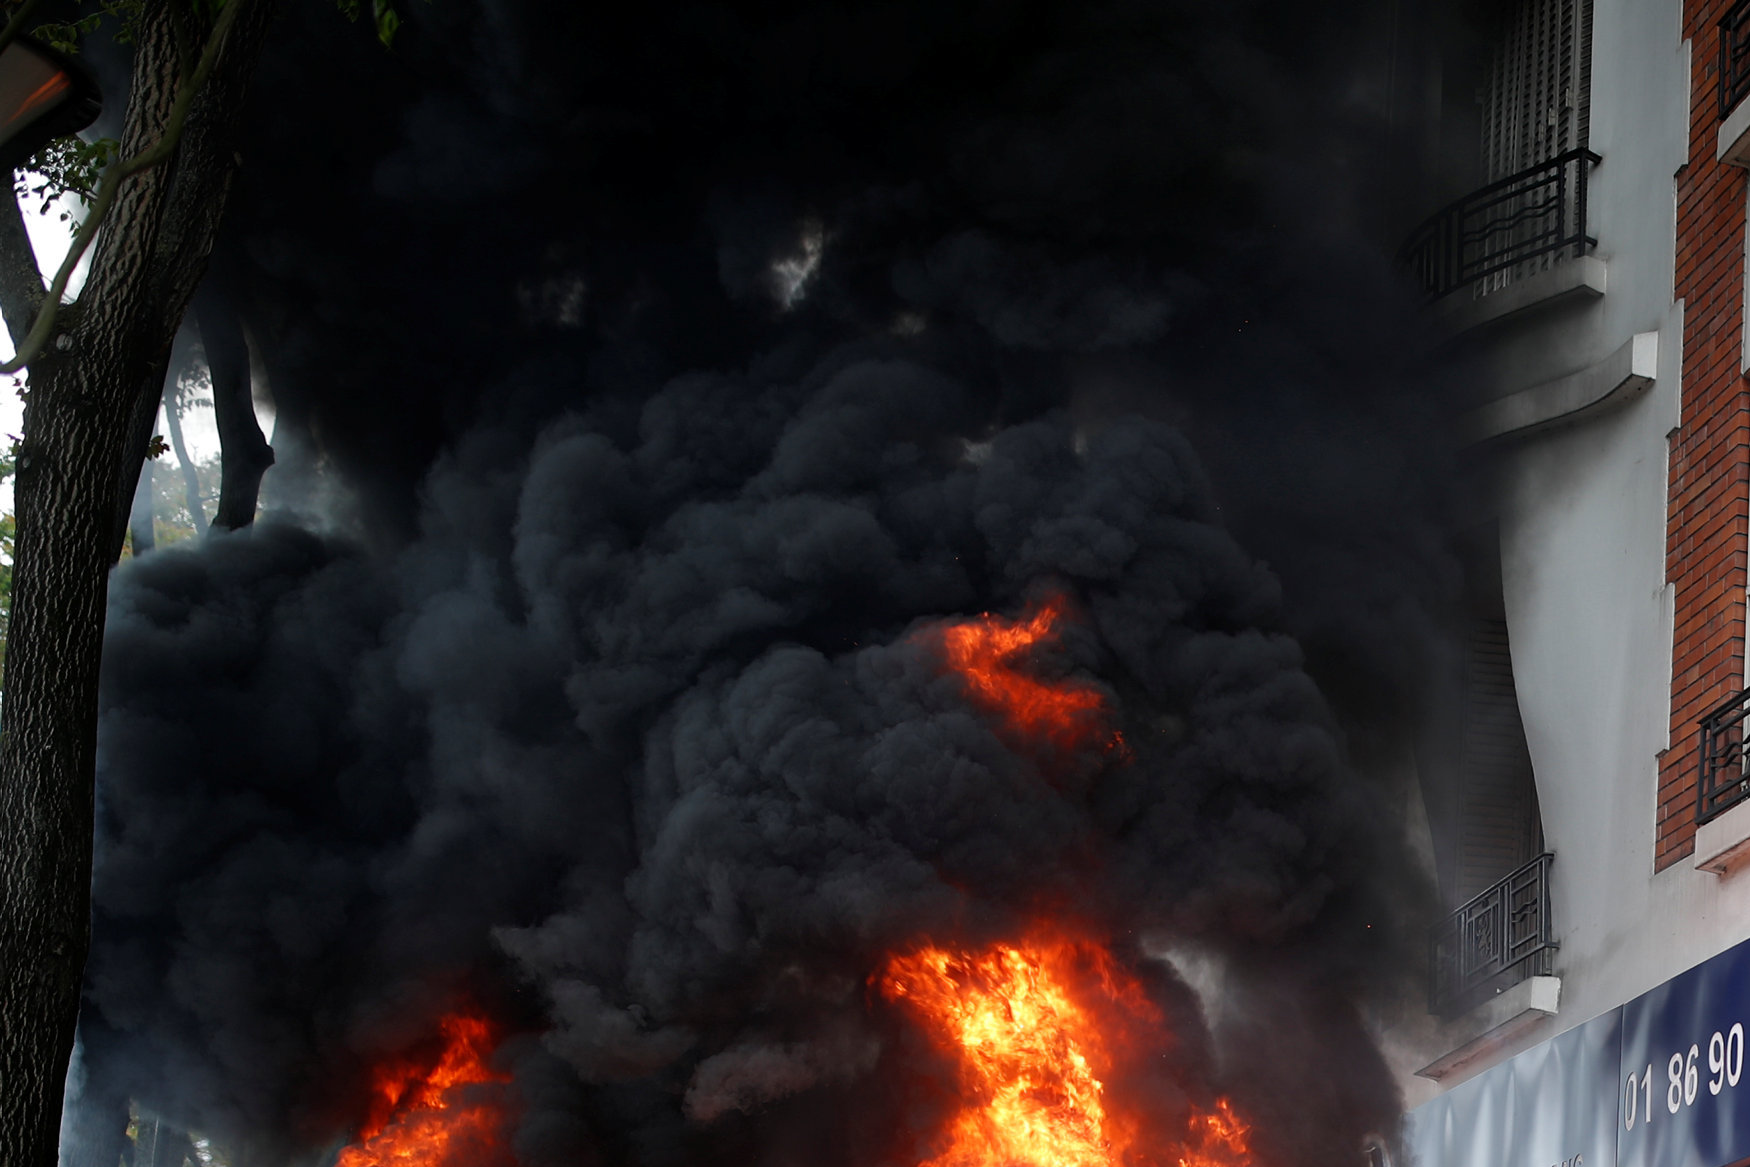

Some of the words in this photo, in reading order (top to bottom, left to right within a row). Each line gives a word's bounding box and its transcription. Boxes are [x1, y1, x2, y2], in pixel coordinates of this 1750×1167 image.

[1624, 1063, 1652, 1131] 01
[1667, 1043, 1699, 1114] 86
[1708, 1022, 1744, 1096] 90
